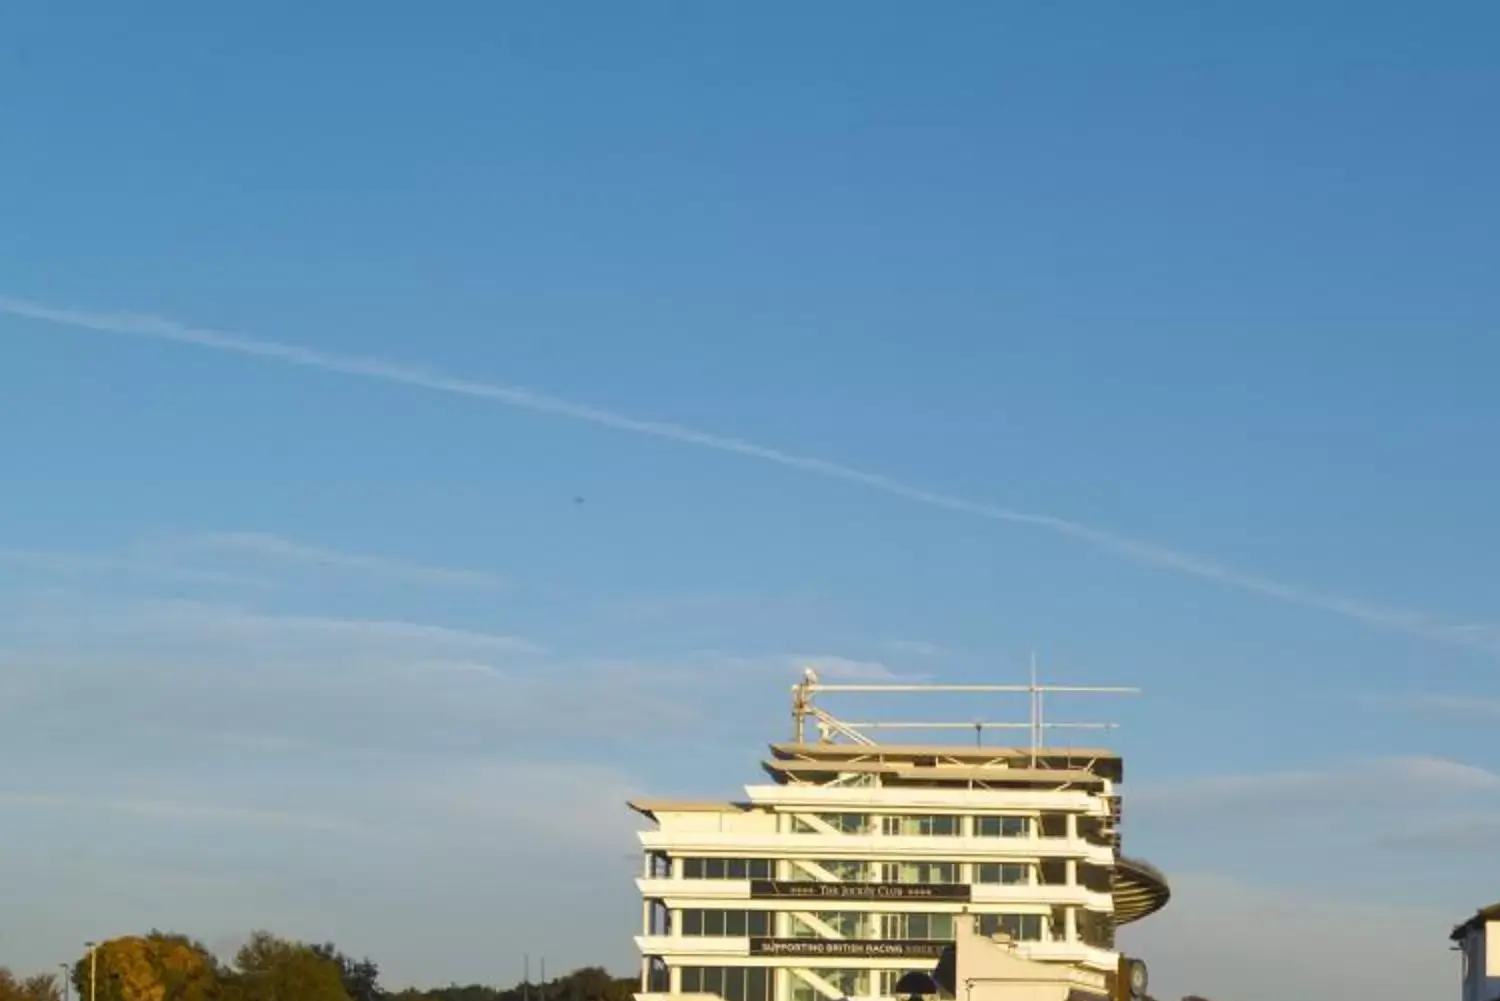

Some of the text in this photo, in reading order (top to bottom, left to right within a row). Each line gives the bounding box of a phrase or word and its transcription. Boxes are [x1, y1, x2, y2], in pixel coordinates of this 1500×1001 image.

[761, 943, 824, 954] SUPPORTING
[826, 943, 864, 954] BRITISH
[866, 943, 903, 954] RACING
